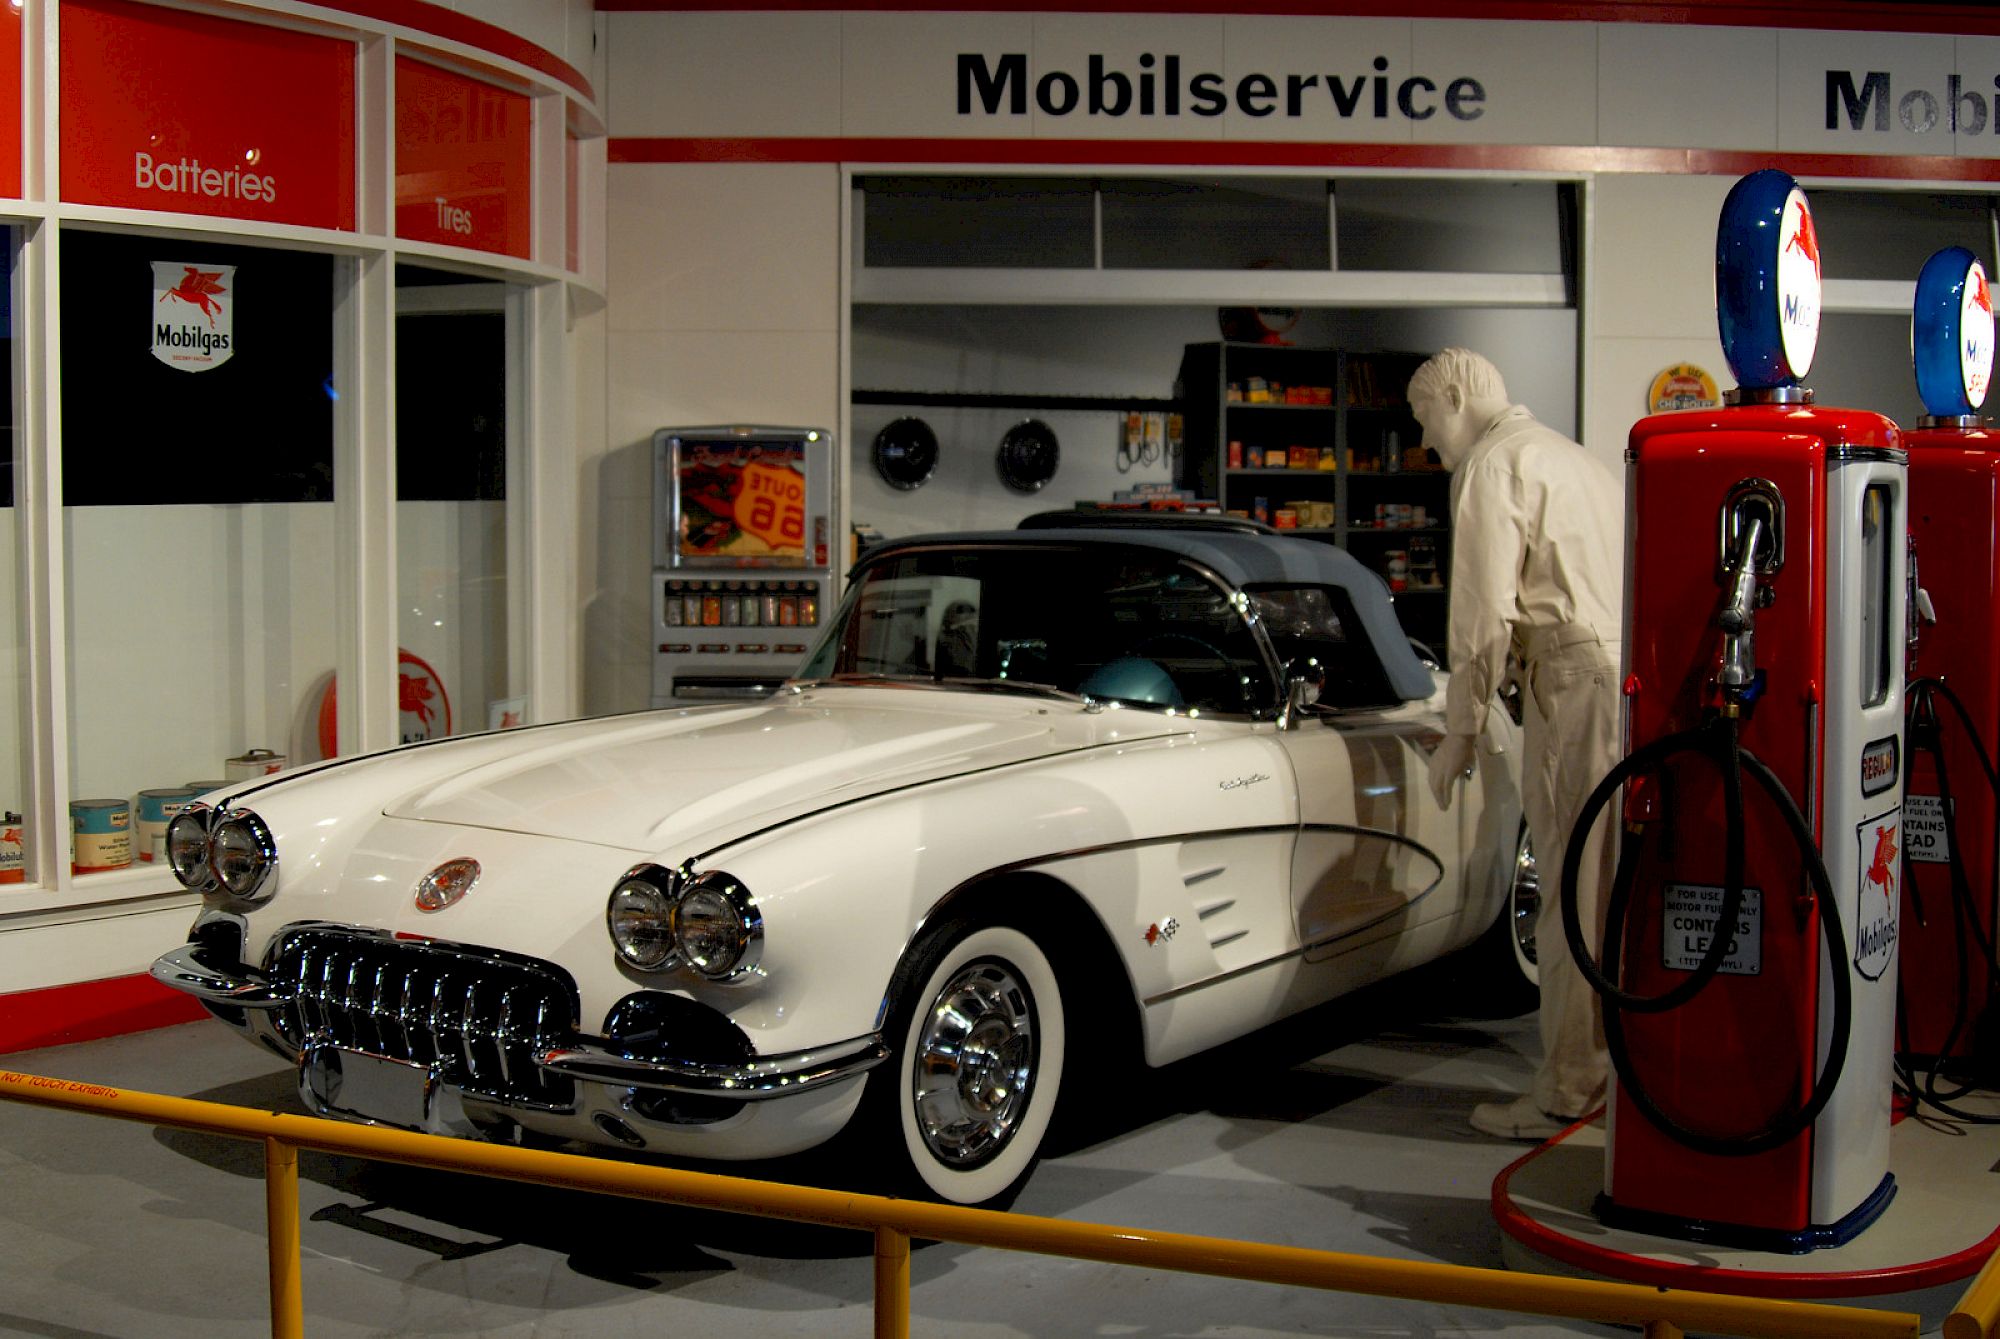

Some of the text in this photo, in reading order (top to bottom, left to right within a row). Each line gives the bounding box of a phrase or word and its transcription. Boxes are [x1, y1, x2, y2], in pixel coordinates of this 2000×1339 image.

[956, 53, 1487, 120] Mobilservice
[135, 151, 276, 203] Batteries
[434, 196, 473, 235] Tires
[156, 323, 229, 355] Mobilgas
[1909, 808, 1928, 816] FUEL
[1903, 820, 1945, 832] NTAINS
[1904, 834, 1936, 848] EAD
[1677, 889, 1696, 899] FOR
[1700, 890, 1720, 901] USE
[1667, 901, 1701, 912] MOTOR
[1740, 906, 1757, 915] NLY
[1685, 936, 1738, 956] LED
[1859, 917, 1896, 959] Mobilgas
[1, 1072, 119, 1099] NOT TOUCH EXHIBITS
